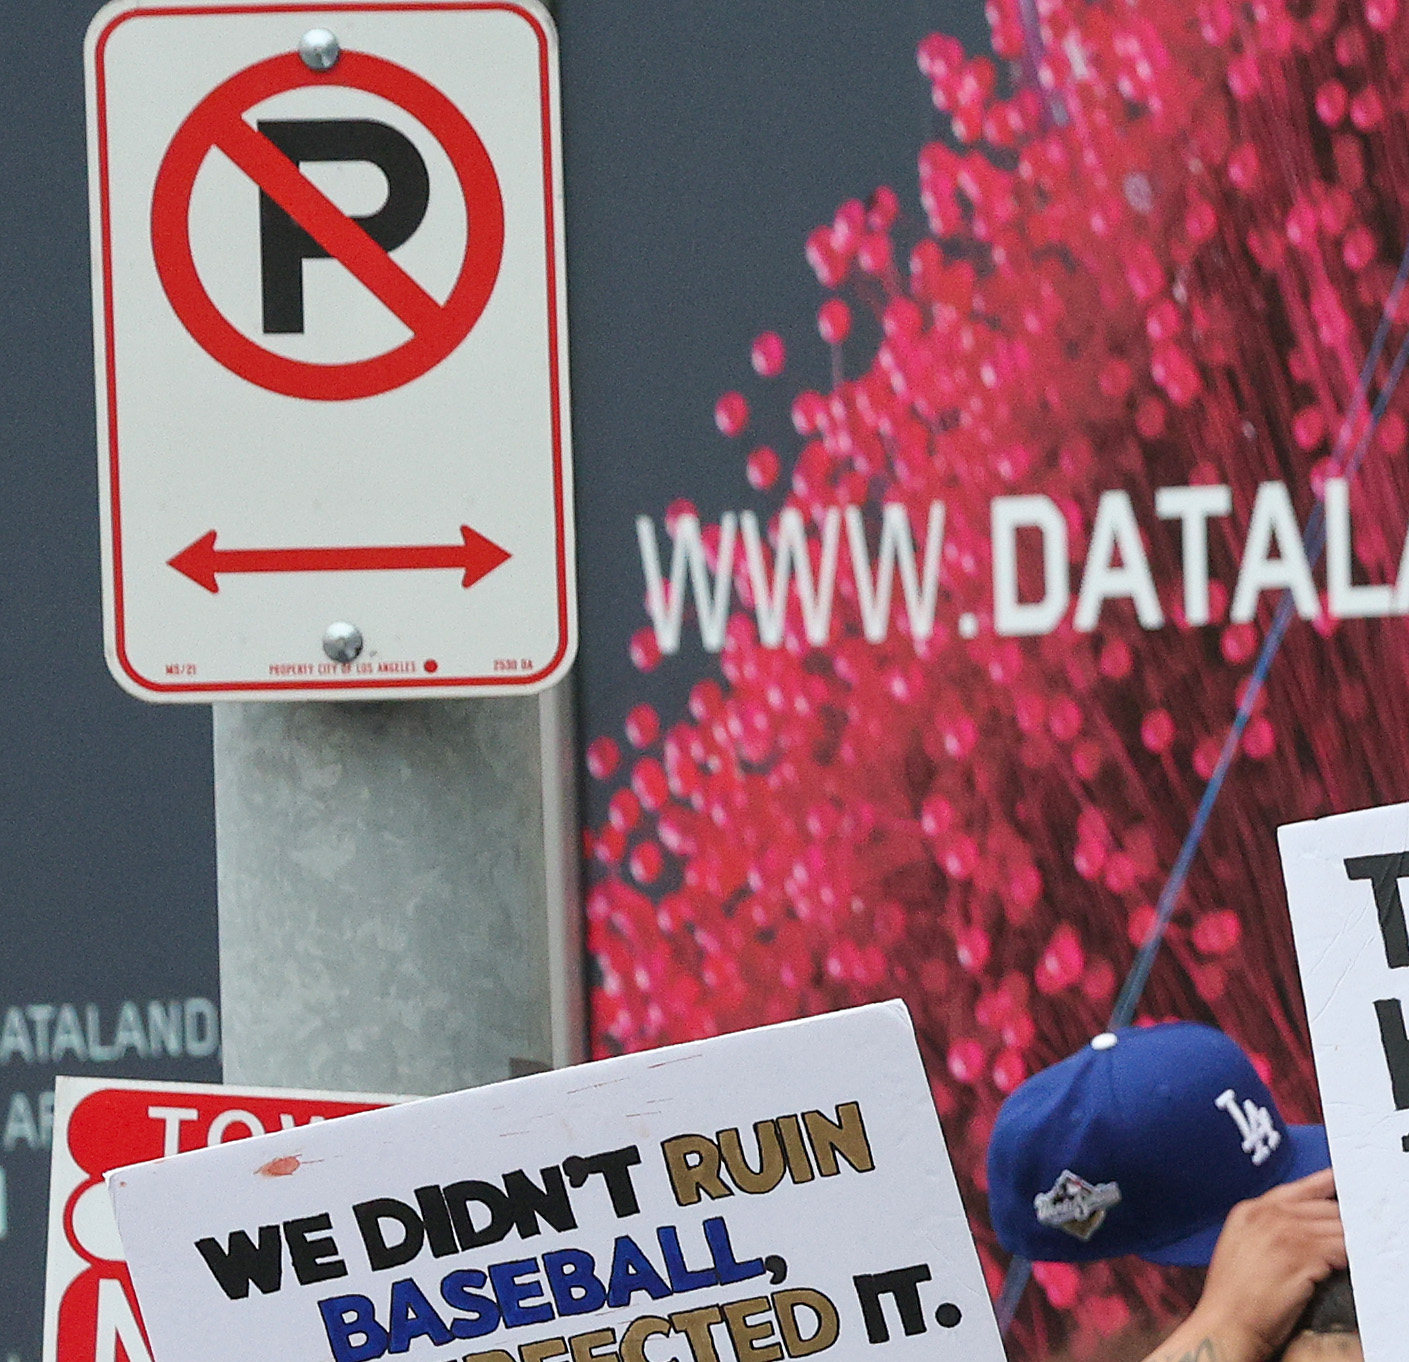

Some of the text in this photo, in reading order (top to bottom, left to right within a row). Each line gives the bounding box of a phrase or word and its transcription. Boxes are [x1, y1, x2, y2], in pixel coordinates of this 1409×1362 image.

[1215, 1088, 1281, 1167] LA
[195, 1101, 874, 1300] WE DIDN'T RUIN
[852, 1264, 961, 1344] IT.
